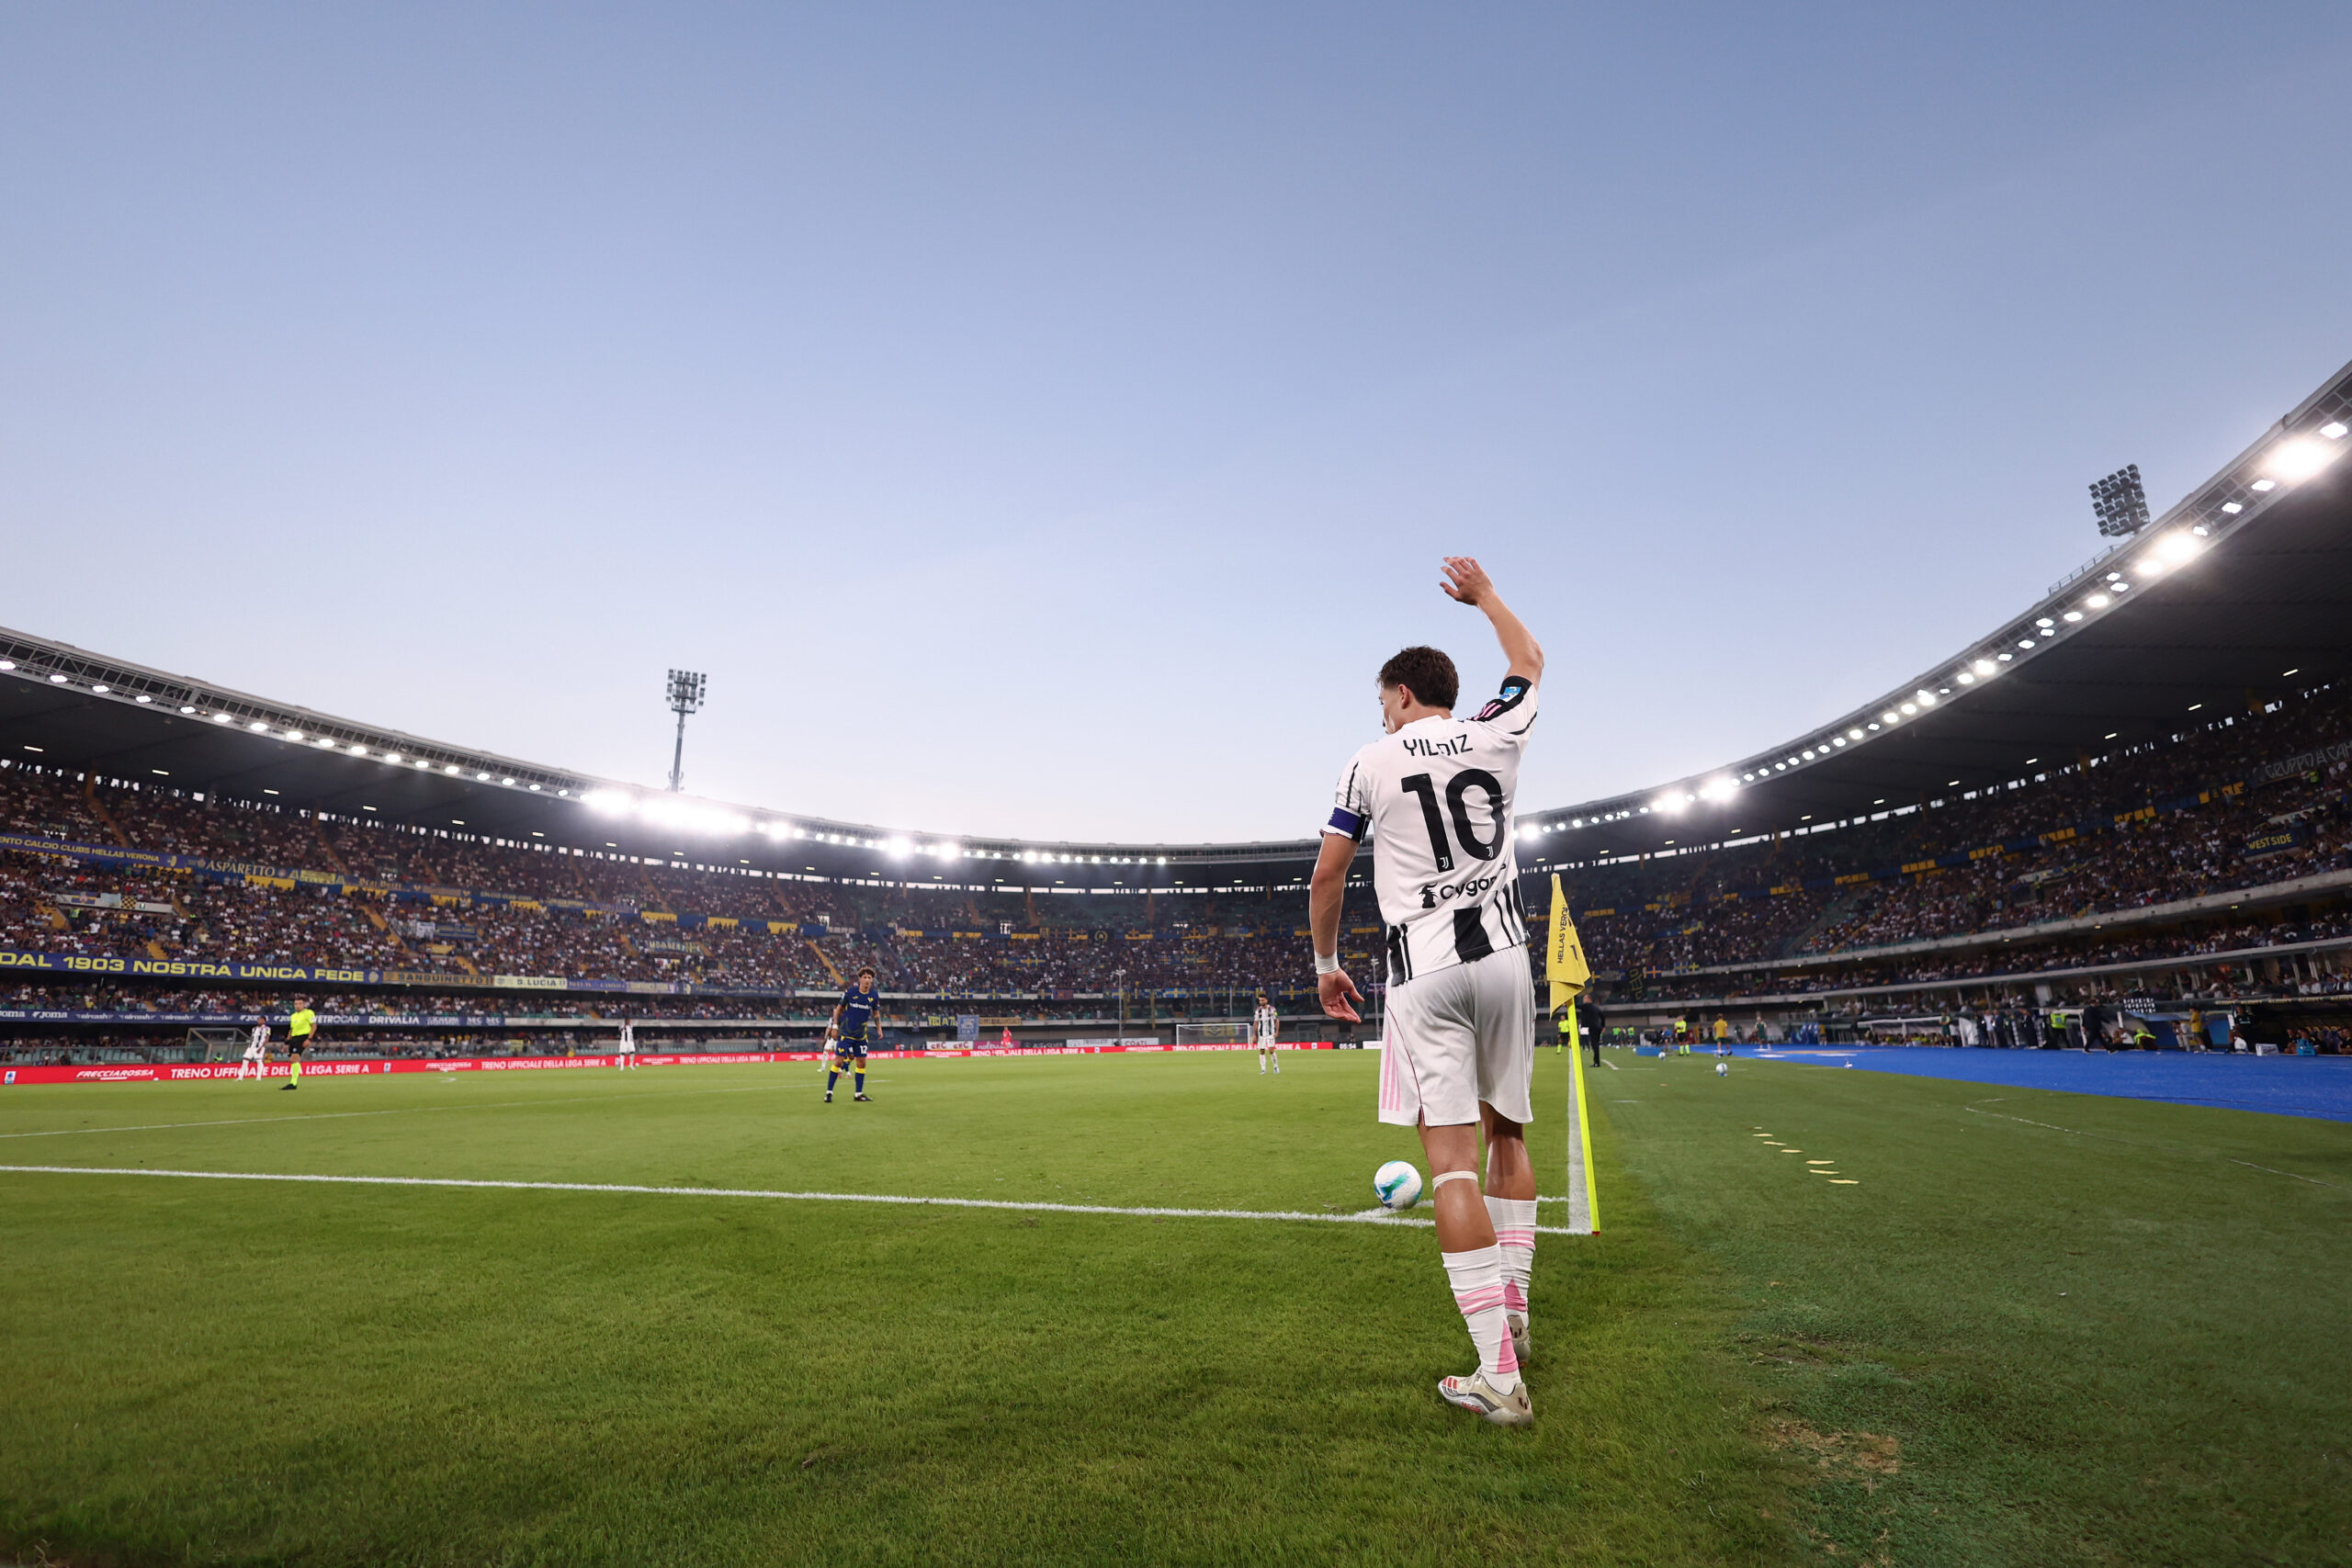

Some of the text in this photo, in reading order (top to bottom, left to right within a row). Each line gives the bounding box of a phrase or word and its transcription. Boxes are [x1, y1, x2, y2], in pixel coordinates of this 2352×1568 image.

[1403, 734, 1474, 756] YILDIZ
[1401, 768, 1506, 874] 10
[2246, 833, 2293, 850] WEST SIDE
[24, 840, 60, 851] CALCIO
[61, 844, 91, 854] CLUBS
[92, 848, 125, 859] HELLAS
[125, 852, 160, 863] VERONA
[206, 860, 276, 876] ASPARETTO
[1557, 932, 1566, 964] HELLAS
[0, 952, 365, 982] DAL 1903 NOSTRA UNICA FEDE
[368, 1016, 420, 1025] DRIVALIA
[860, 1045, 868, 1055] 12
[171, 1067, 211, 1078] TRENO
[213, 1066, 269, 1077] UFFIIAE
[306, 1065, 333, 1074] LEGA
[334, 1064, 361, 1074] SERIE
[361, 1064, 369, 1073] A
[481, 1060, 506, 1070] TRENO
[508, 1060, 543, 1069] UFFICIALE
[543, 1059, 563, 1068] DELLA
[565, 1059, 582, 1067] LEGA
[584, 1058, 601, 1066] SERIE
[76, 1069, 154, 1077] FRECCIAROSSA
